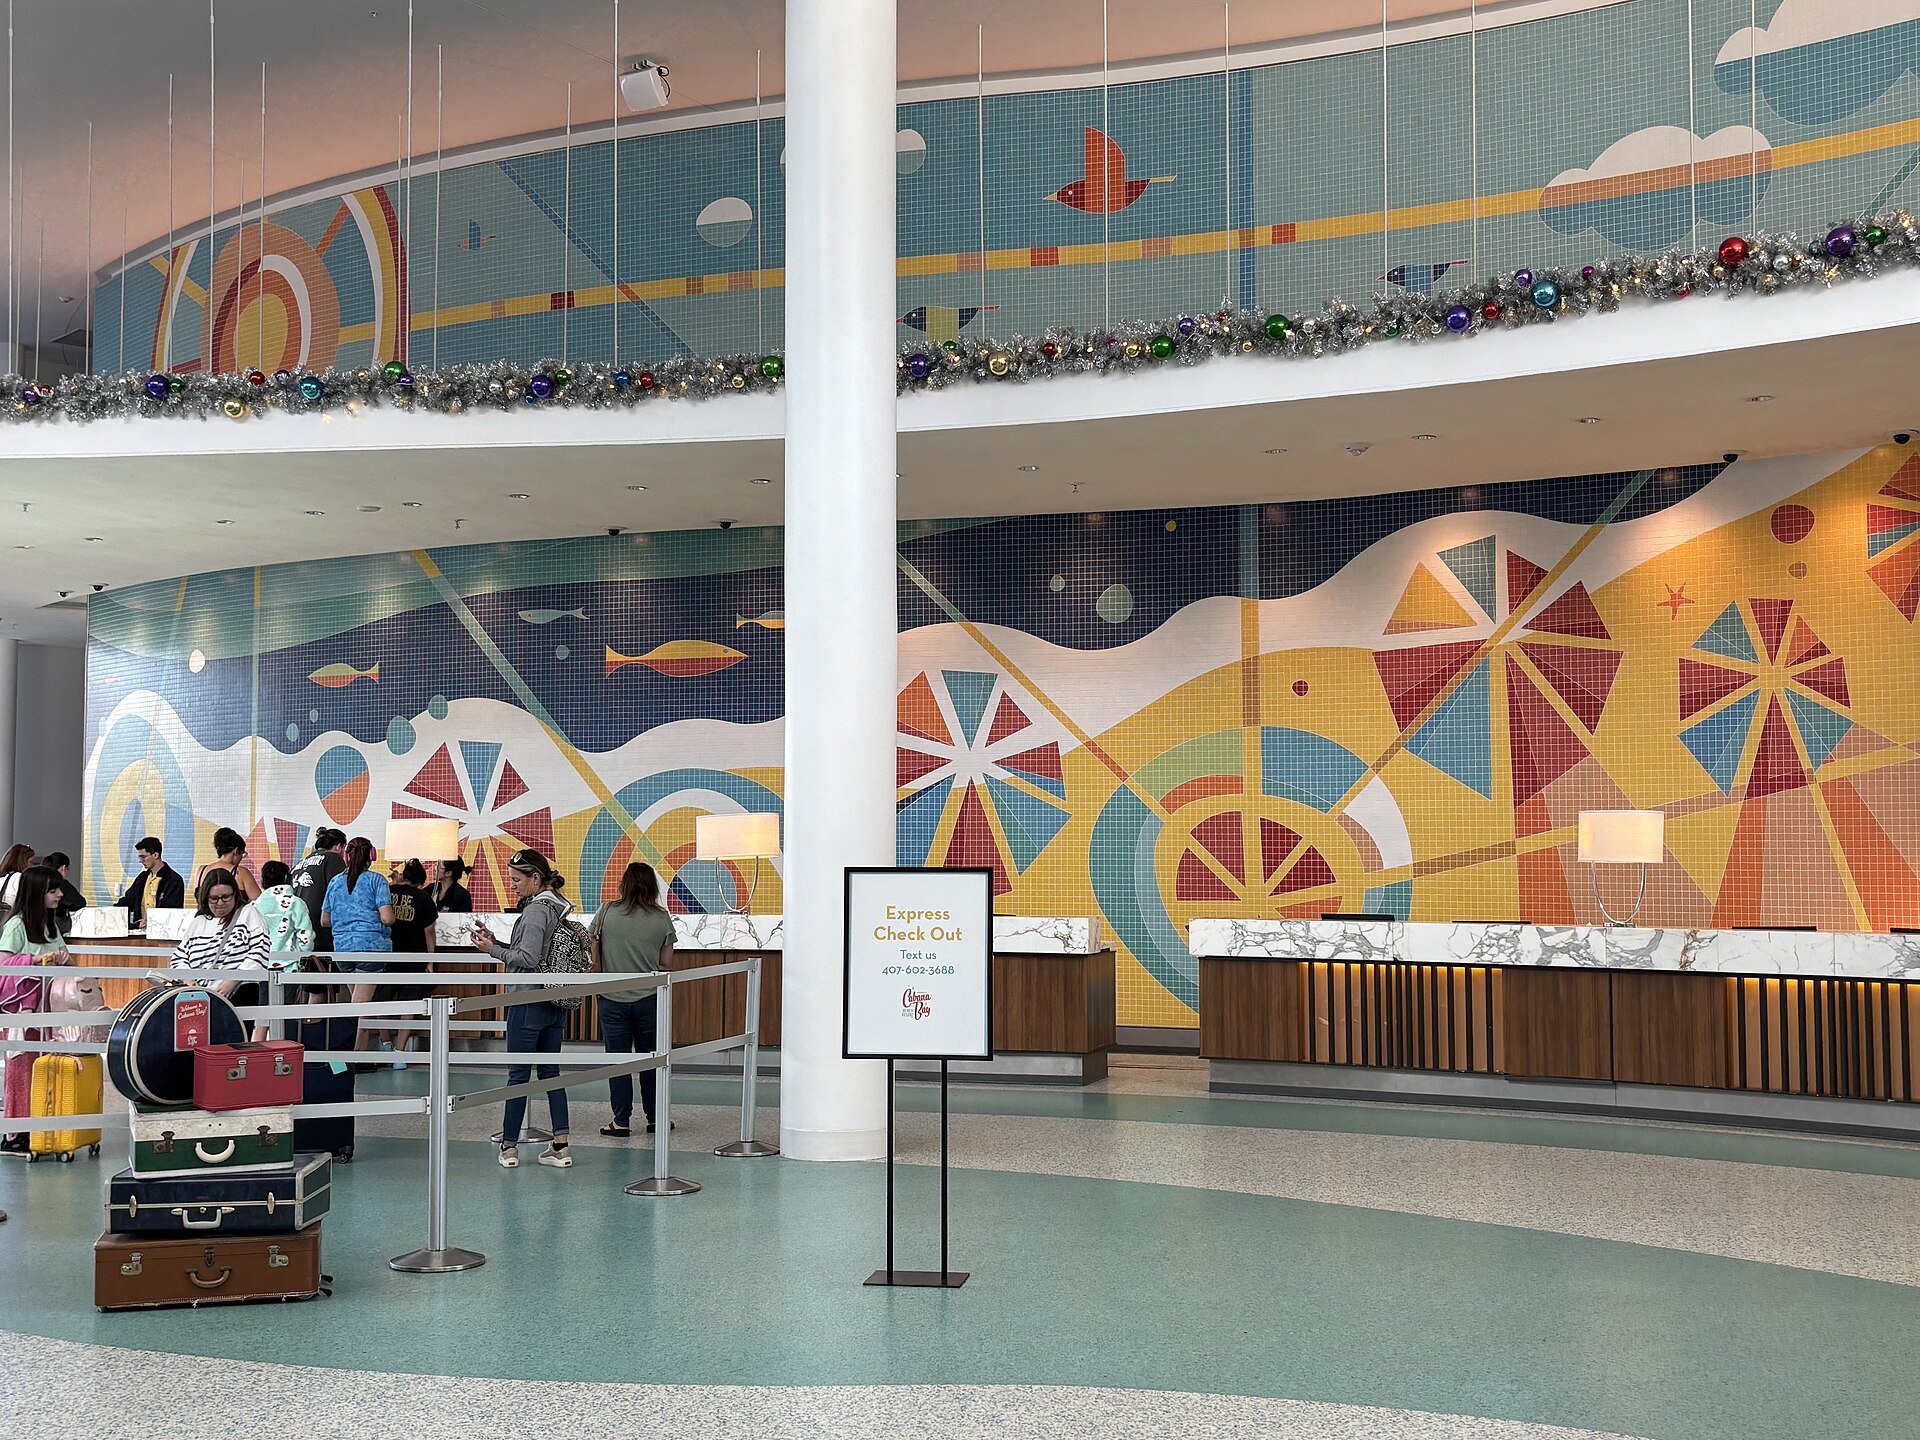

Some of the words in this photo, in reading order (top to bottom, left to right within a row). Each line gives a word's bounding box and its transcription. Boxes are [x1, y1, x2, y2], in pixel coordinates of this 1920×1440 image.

[886, 905, 950, 923] Express
[874, 926, 925, 941] Check
[930, 926, 962, 941] Out
[900, 950, 922, 960] Text
[925, 951, 937, 960] us
[882, 965, 955, 975] 407-602-3688
[902, 988, 931, 1008] Cabana
[914, 1001, 931, 1020] Bay
